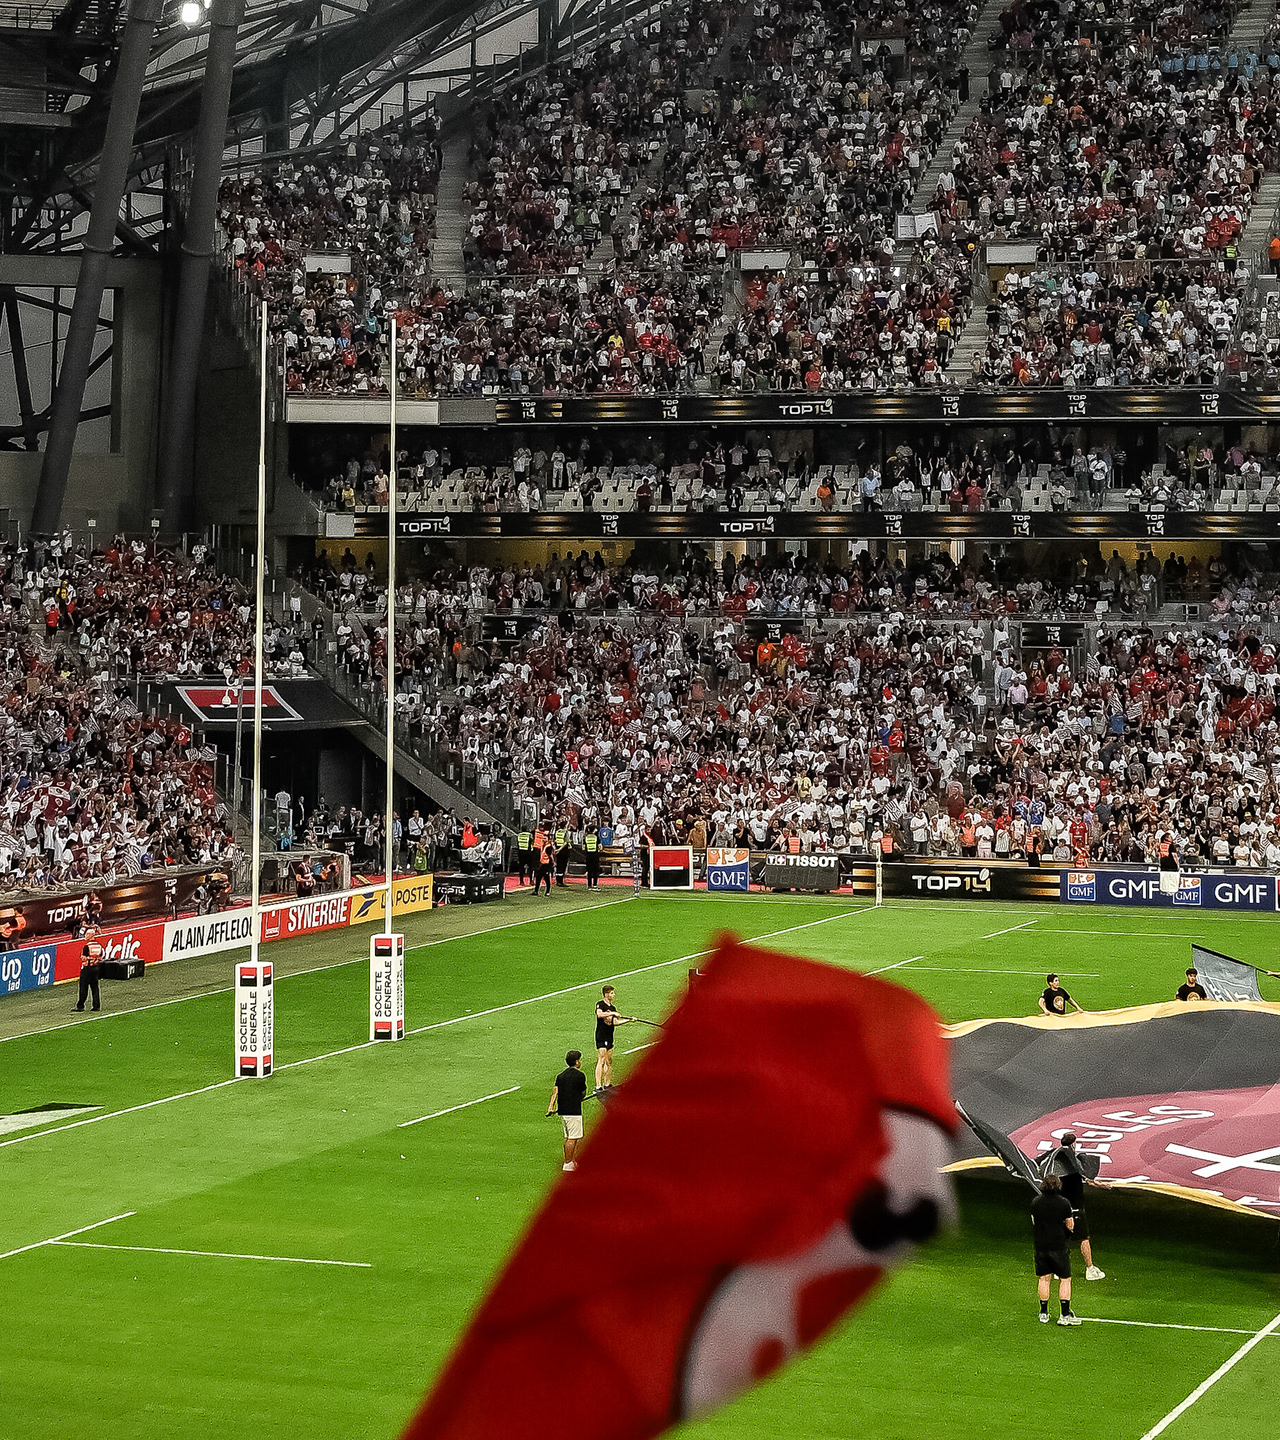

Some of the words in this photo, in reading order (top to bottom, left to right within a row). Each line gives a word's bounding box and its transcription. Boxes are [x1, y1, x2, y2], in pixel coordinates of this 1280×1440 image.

[779, 404, 833, 414] TOP14
[400, 521, 450, 532] TOP14
[720, 521, 774, 532] TOP14
[787, 855, 838, 867] TISSOT
[164, 878, 178, 888] TOP
[710, 871, 746, 886] GMF
[912, 874, 990, 892] TOP14
[394, 884, 430, 907] POSTE
[1070, 887, 1093, 898] GMF
[1109, 879, 1159, 900] GMF
[1175, 891, 1198, 901] GMF
[1214, 882, 1268, 904] GMF
[287, 897, 350, 932] SYNERGIE
[170, 926, 206, 953] ALAIN
[384, 960, 392, 1018] GENERALE
[240, 1002, 248, 1052] SOCIETE
[250, 991, 258, 1053] GENERALE
